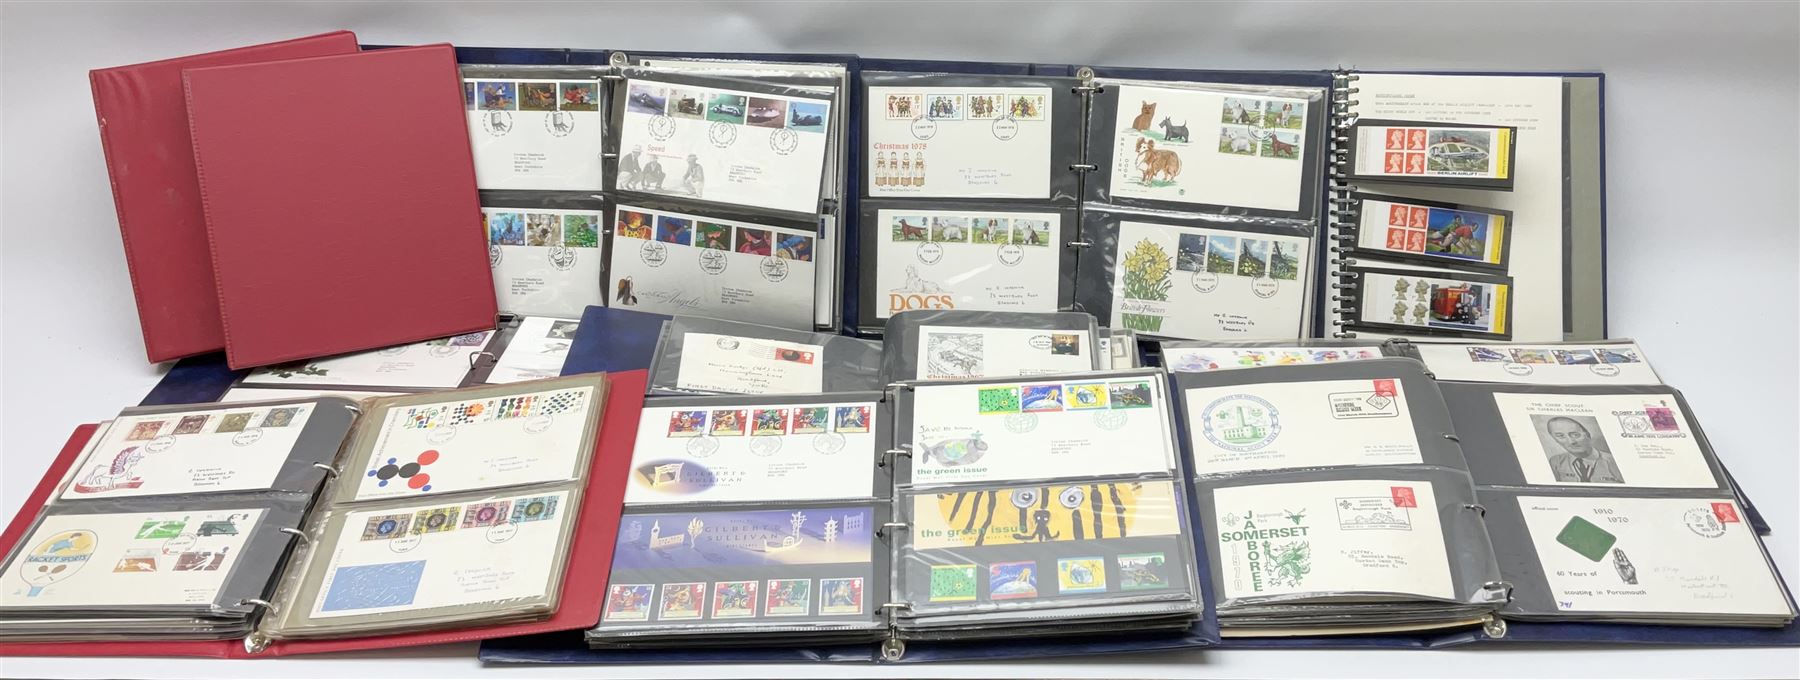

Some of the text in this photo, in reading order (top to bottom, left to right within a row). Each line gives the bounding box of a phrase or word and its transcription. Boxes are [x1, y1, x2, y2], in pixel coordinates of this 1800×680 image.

[648, 144, 666, 153] Speed
[889, 293, 955, 311] DOGS
[1121, 302, 1142, 312] British
[934, 467, 960, 476] green
[1607, 515, 1629, 523] 1970
[705, 525, 768, 534] GILBERT
[920, 523, 1026, 540] the green issue
[1221, 525, 1310, 543] SOMERSET
[706, 533, 779, 542] SULLIVAN
[1243, 509, 1264, 593] JAMBOREE
[61, 554, 87, 562] SPORTS
[1231, 544, 1244, 592] 1970
[1564, 590, 1593, 598] scouting
